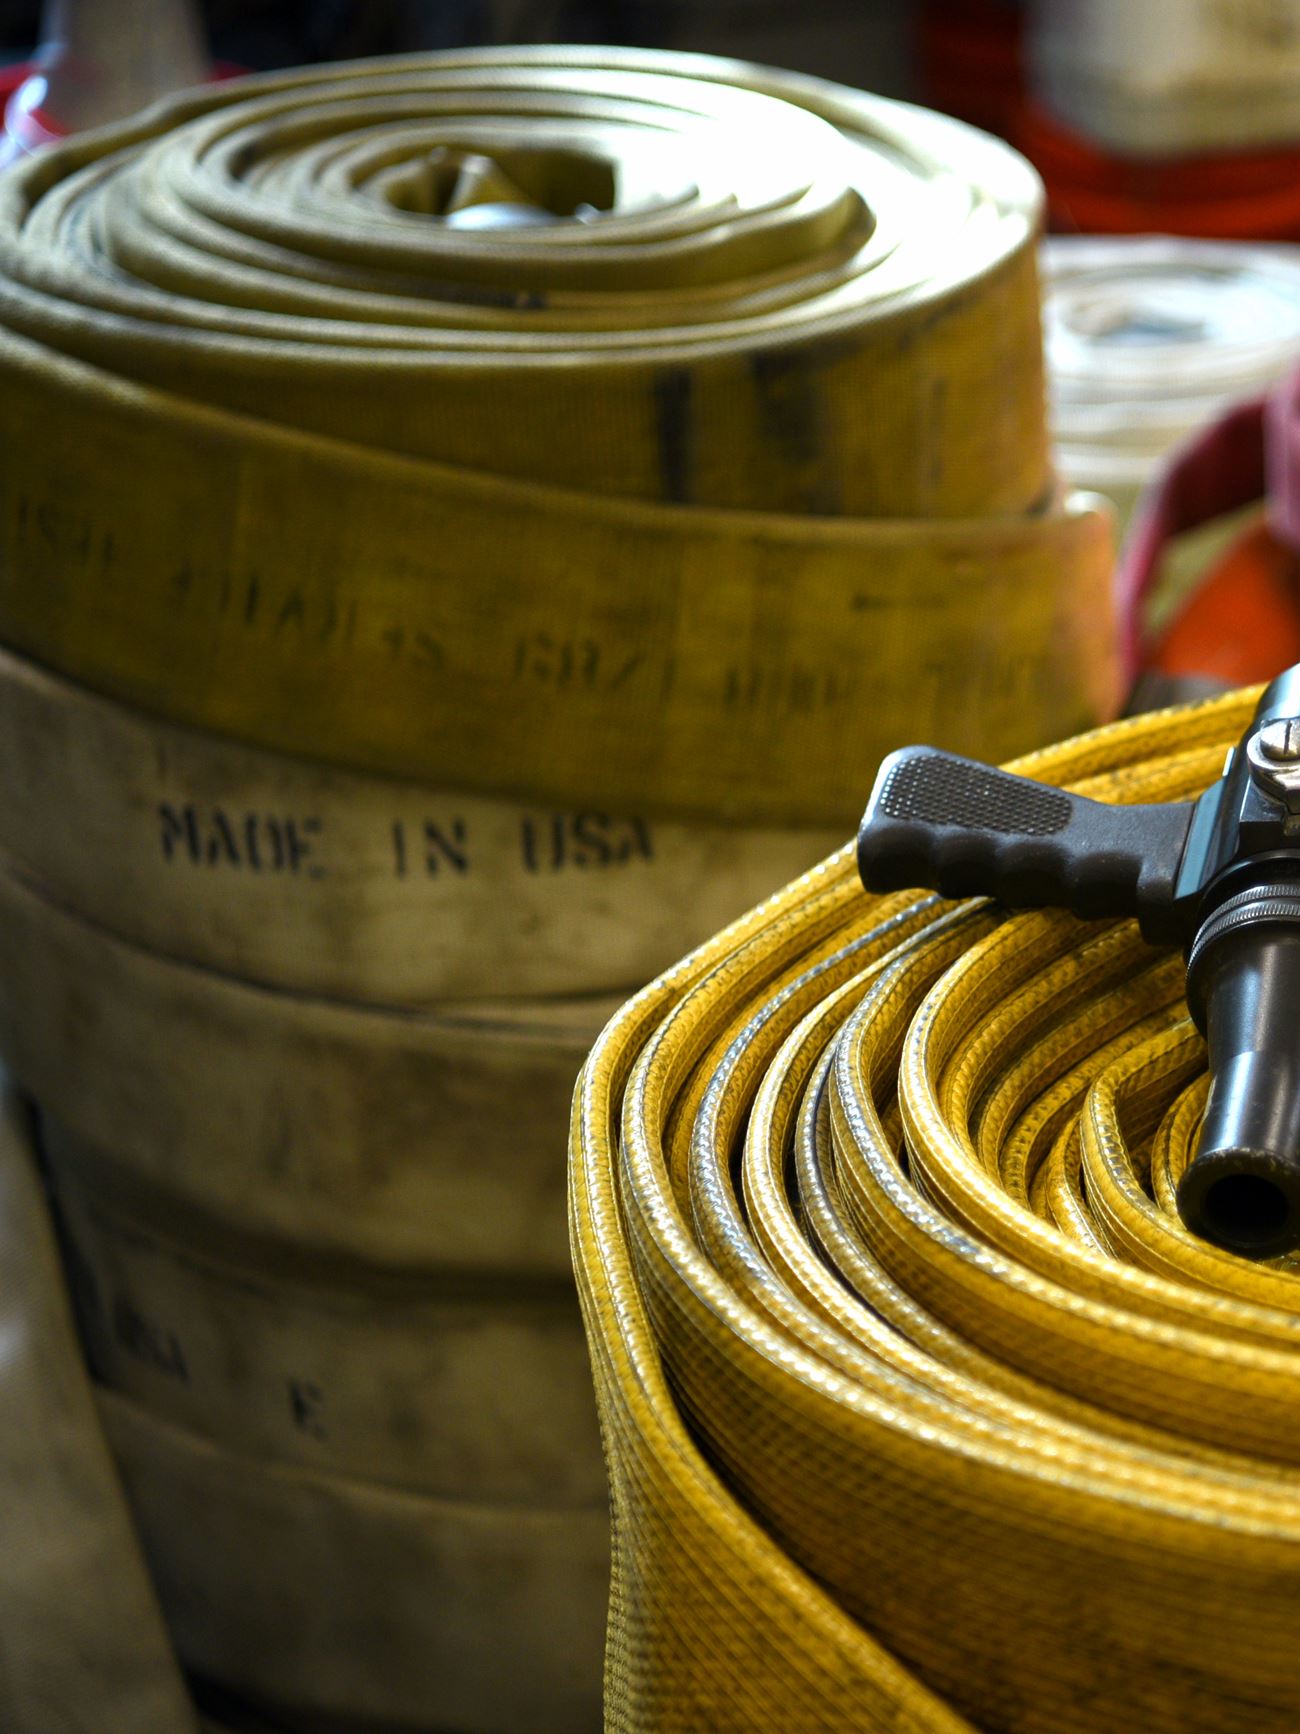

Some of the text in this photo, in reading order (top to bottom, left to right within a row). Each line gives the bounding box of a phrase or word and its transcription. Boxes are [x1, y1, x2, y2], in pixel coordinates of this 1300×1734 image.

[159, 803, 656, 881] MADE IN USA
